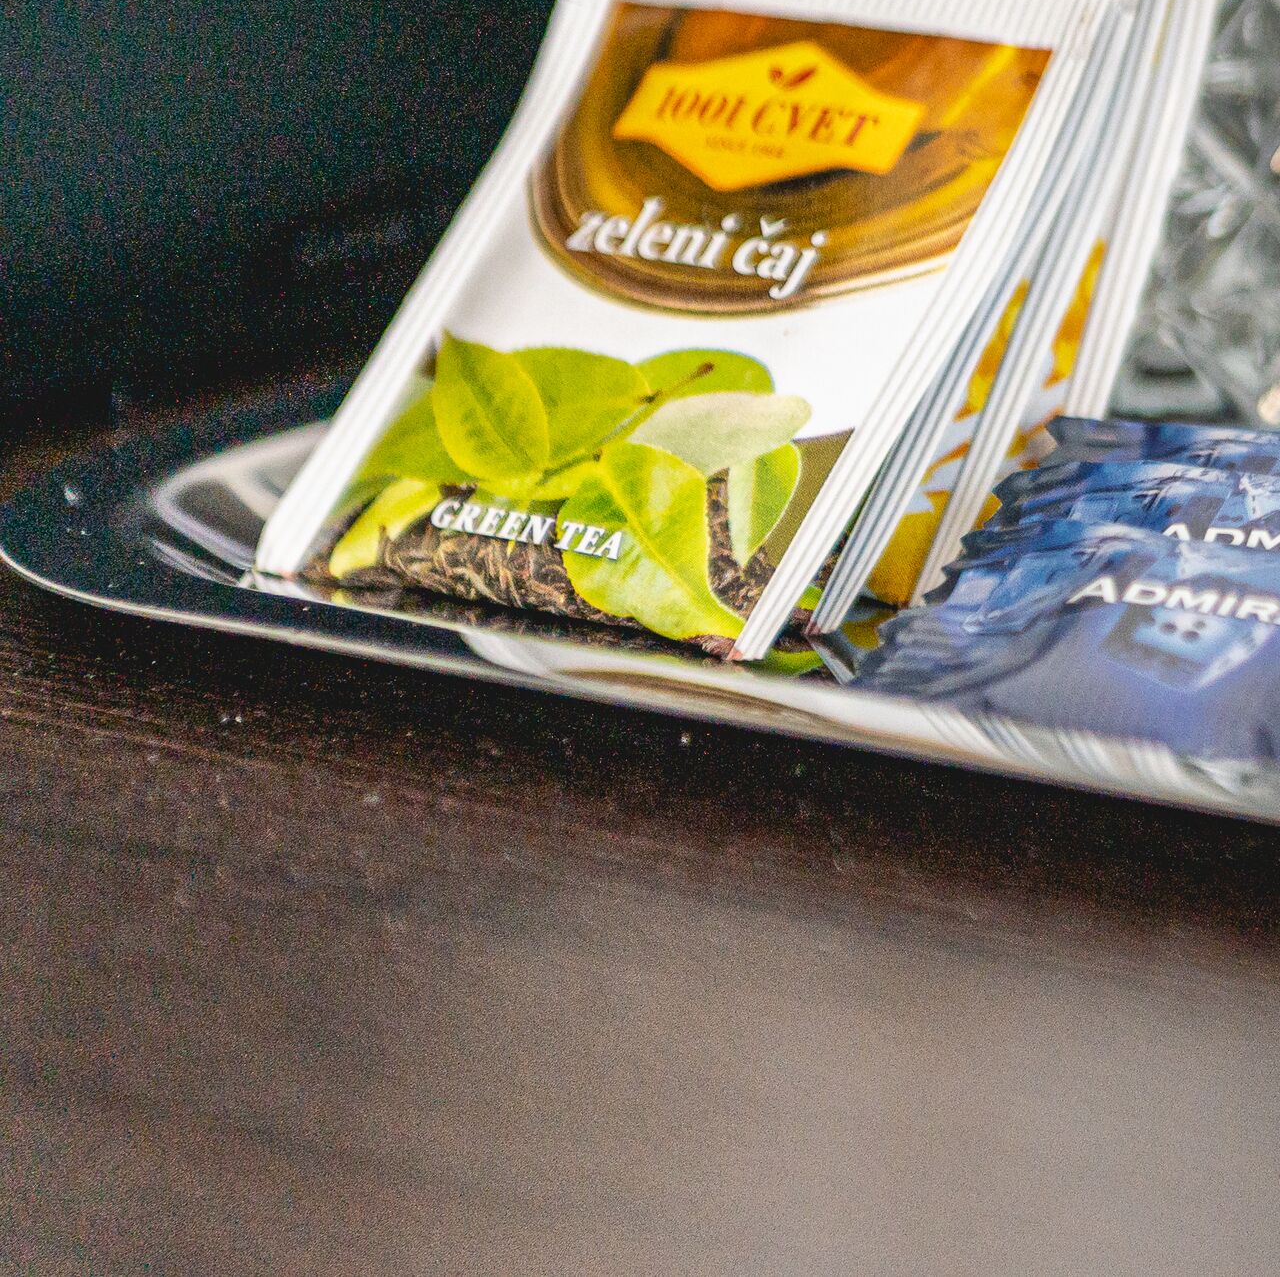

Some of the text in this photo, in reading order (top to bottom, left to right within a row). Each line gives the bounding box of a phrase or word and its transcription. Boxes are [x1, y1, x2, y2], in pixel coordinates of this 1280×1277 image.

[565, 195, 831, 301] zeleni čaj
[430, 496, 626, 562] GREEN TEA
